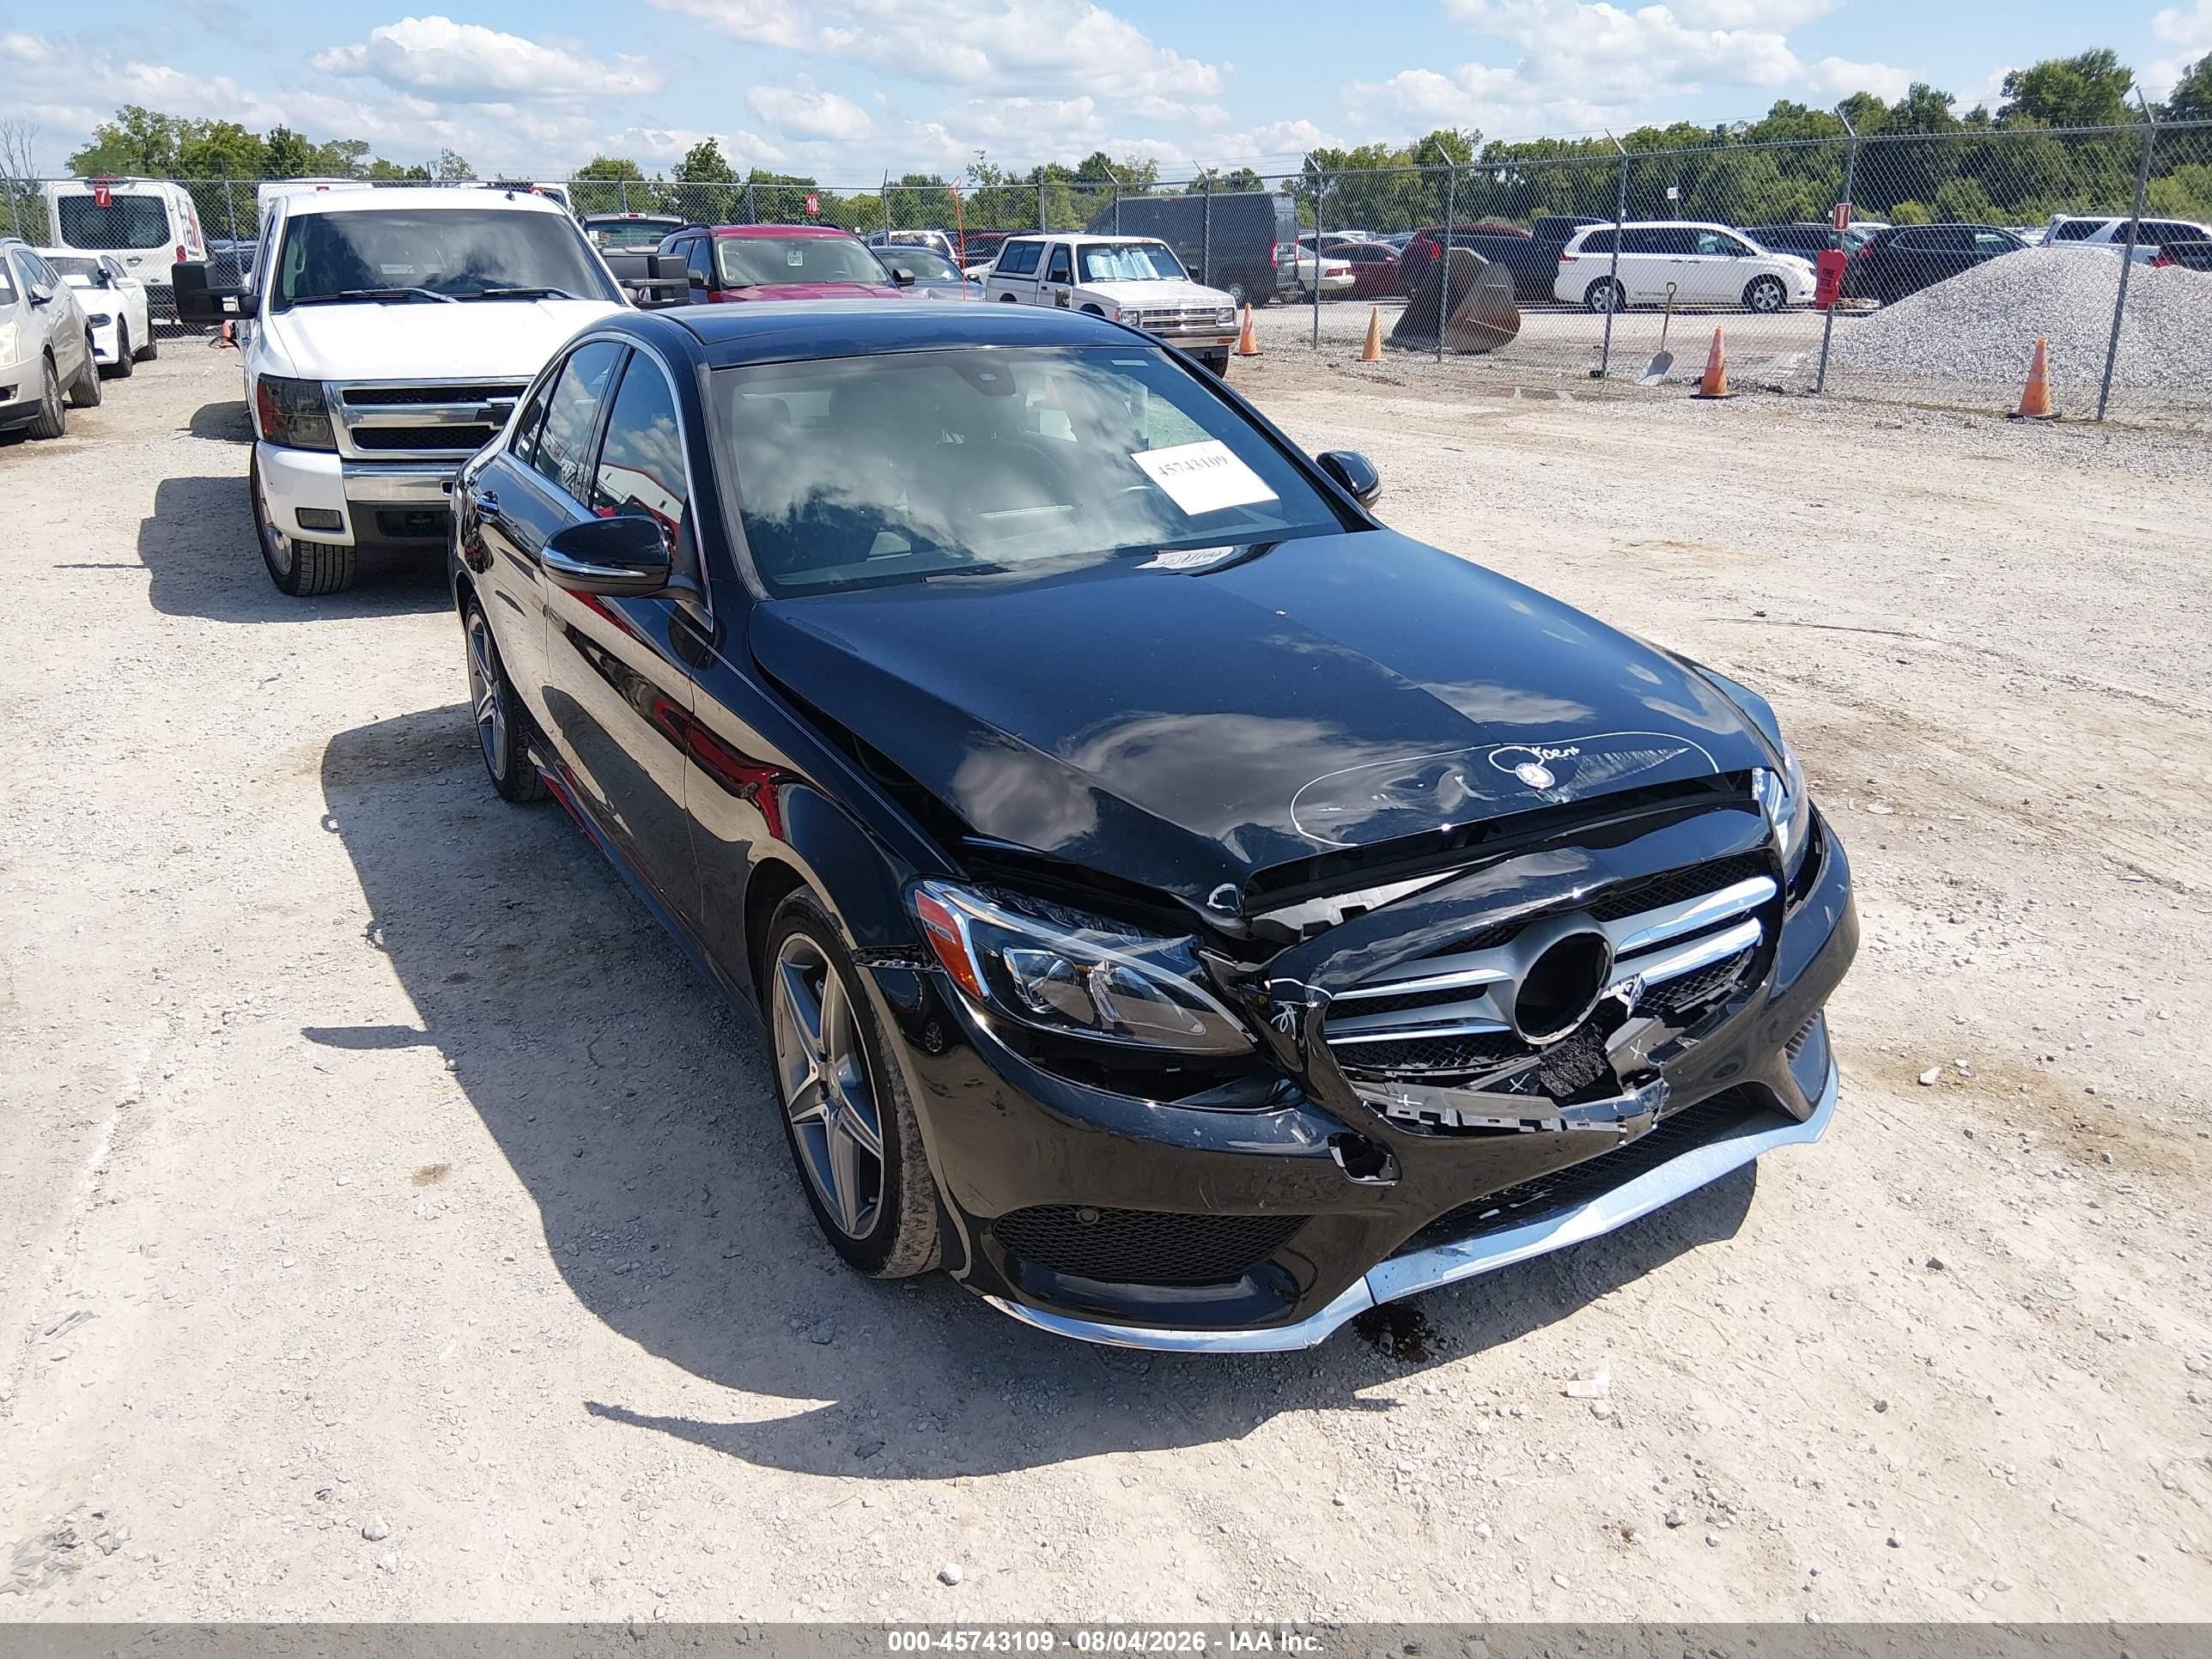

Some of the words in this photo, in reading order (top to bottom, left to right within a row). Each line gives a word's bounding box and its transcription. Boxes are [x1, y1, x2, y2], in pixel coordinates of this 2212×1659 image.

[95, 187, 108, 204] 7
[807, 197, 817, 213] 10
[1158, 454, 1229, 477] 45743109
